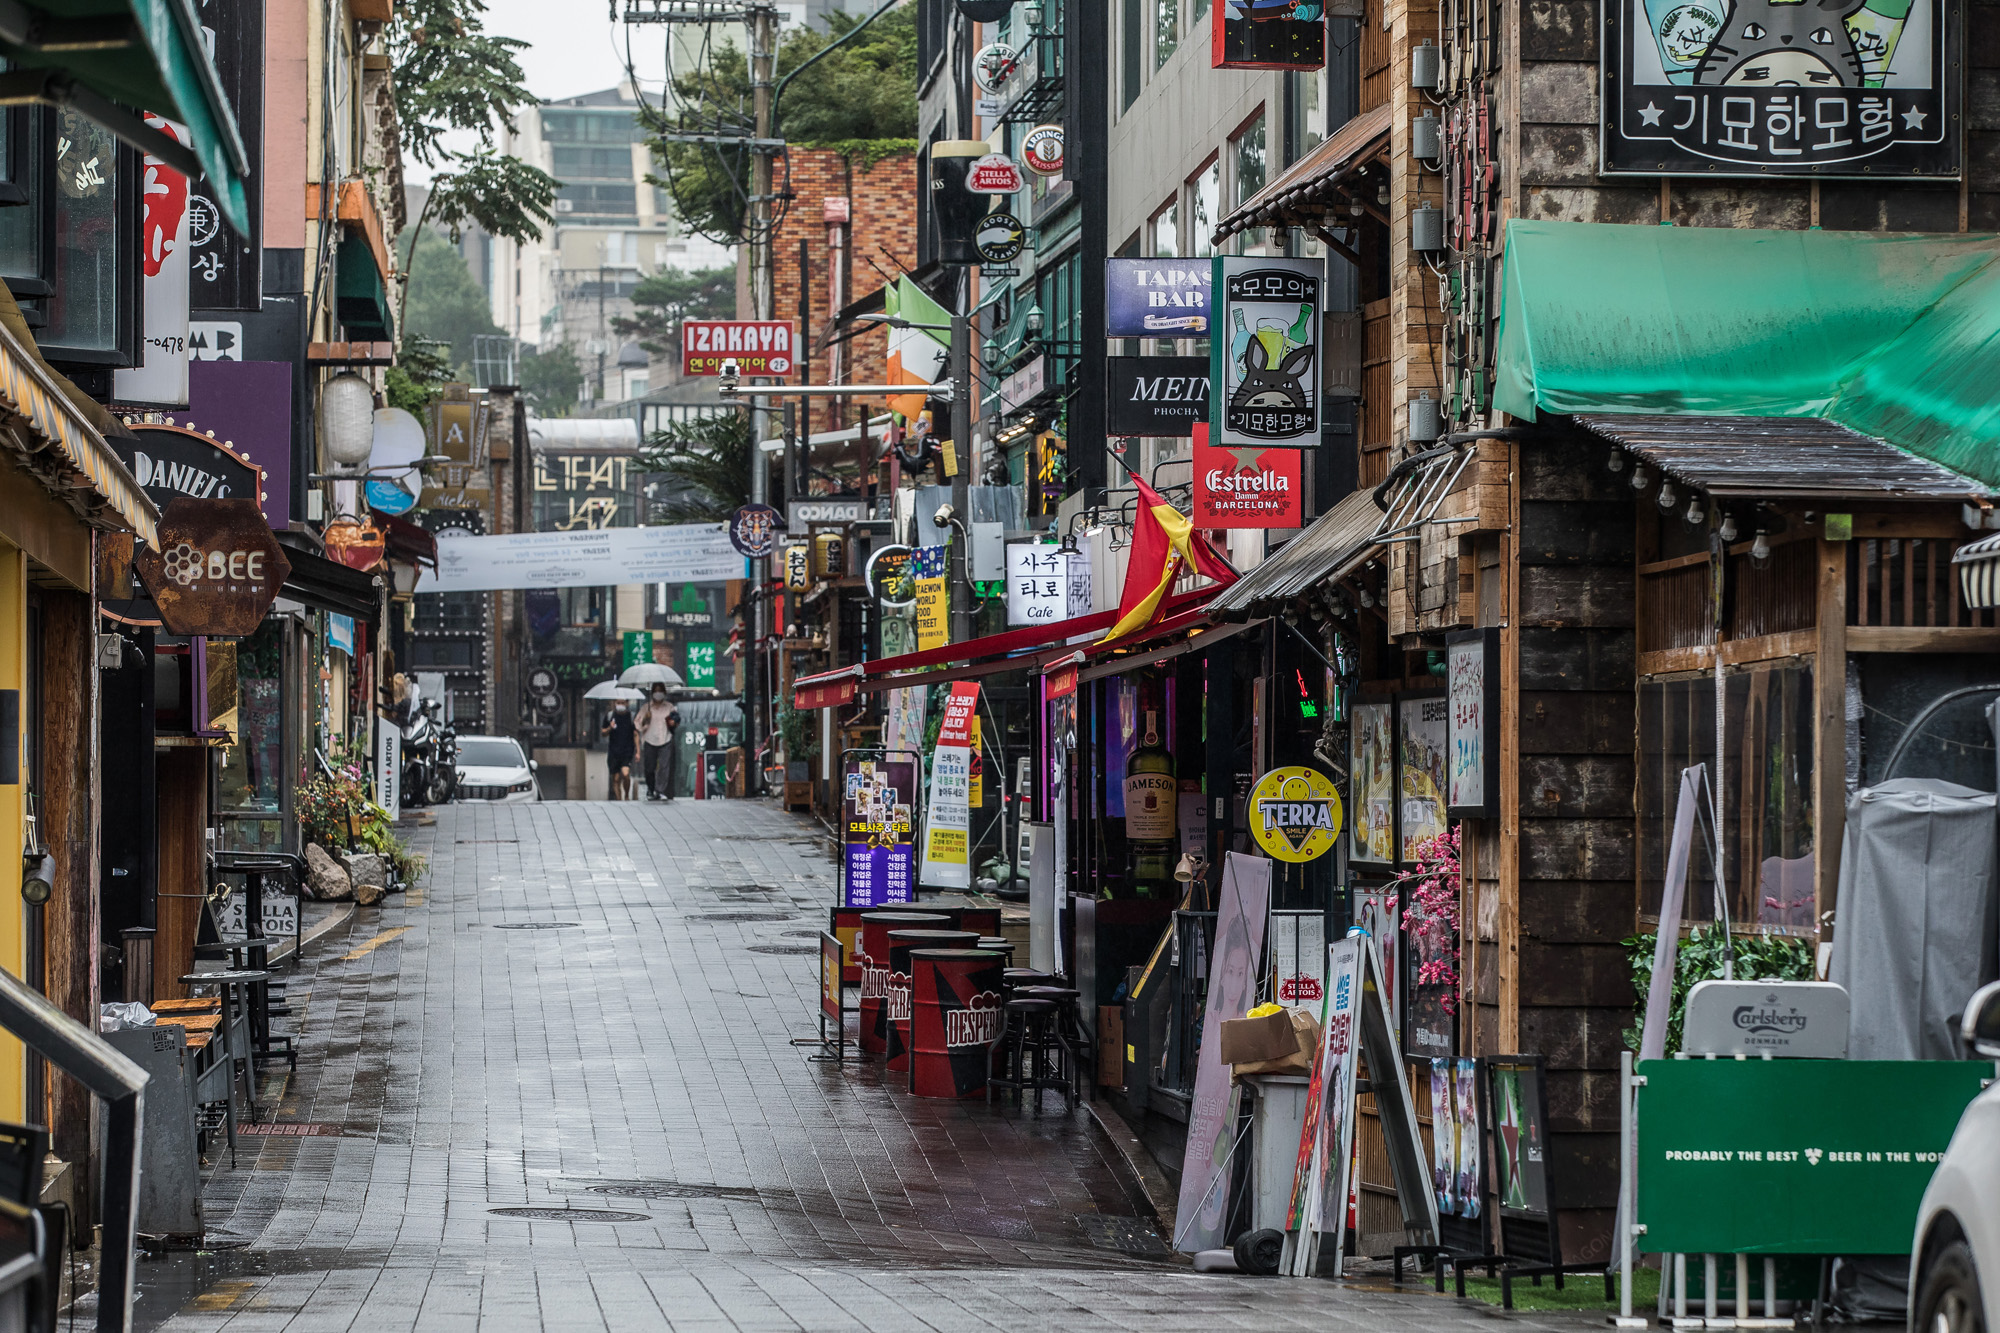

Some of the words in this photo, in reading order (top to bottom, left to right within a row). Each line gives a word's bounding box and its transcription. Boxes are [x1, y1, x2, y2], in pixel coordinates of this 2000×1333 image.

[1673, 94, 1893, 156] 기묘한모험
[980, 170, 1011, 178] STELLA
[983, 216, 1015, 228] GOOSE
[984, 245, 1018, 259] ISLAND
[192, 252, 224, 282] 상
[1242, 277, 1305, 299] 모모의
[1148, 291, 1204, 308] BAR
[144, 337, 184, 355] -0478
[688, 326, 788, 352] IZAKAYA
[689, 358, 767, 373] 엔이카야
[774, 360, 785, 370] 2F
[1154, 408, 1199, 416] PHOCHA
[1237, 412, 1306, 433] 기묘한모험
[446, 422, 464, 443] A
[558, 456, 632, 491] THAT
[1205, 468, 1289, 492] Estrella
[1235, 492, 1259, 500] Damm
[1215, 501, 1279, 509] BARCELONA
[208, 550, 265, 580] BEE
[1020, 552, 1059, 573] 사주
[789, 552, 806, 588] おでん
[1021, 579, 1060, 600] 타로
[917, 595, 937, 606] WORLD
[917, 607, 931, 617] FOOD
[1027, 606, 1053, 618] Cafe
[917, 618, 937, 629] STREET
[688, 646, 714, 662] 부산
[689, 664, 713, 680] 갈비
[1128, 778, 1173, 793] JAMESON
[1260, 803, 1334, 831] TERRA
[849, 822, 910, 833] 모토사주&타로
[852, 853, 872, 861] 애정운
[887, 854, 907, 862] 시험운
[852, 862, 872, 871] 이성운
[887, 862, 907, 871] 건강운
[852, 871, 872, 879] 취업운
[887, 880, 907, 888] 진학운
[852, 889, 872, 897] 사업운
[887, 889, 907, 897] 이사운
[233, 904, 294, 918] SLLA
[232, 918, 294, 932] AOIS
[1732, 1006, 1807, 1033] Carlsberg
[1744, 1037, 1790, 1045] DENMARK
[1665, 1150, 1733, 1162] PROBABLY
[1737, 1150, 1763, 1162] THE
[1767, 1151, 1799, 1162] BEST
[1828, 1151, 1862, 1162] BEER
[1866, 1151, 1882, 1162] IN
[1885, 1152, 1911, 1163] THE
